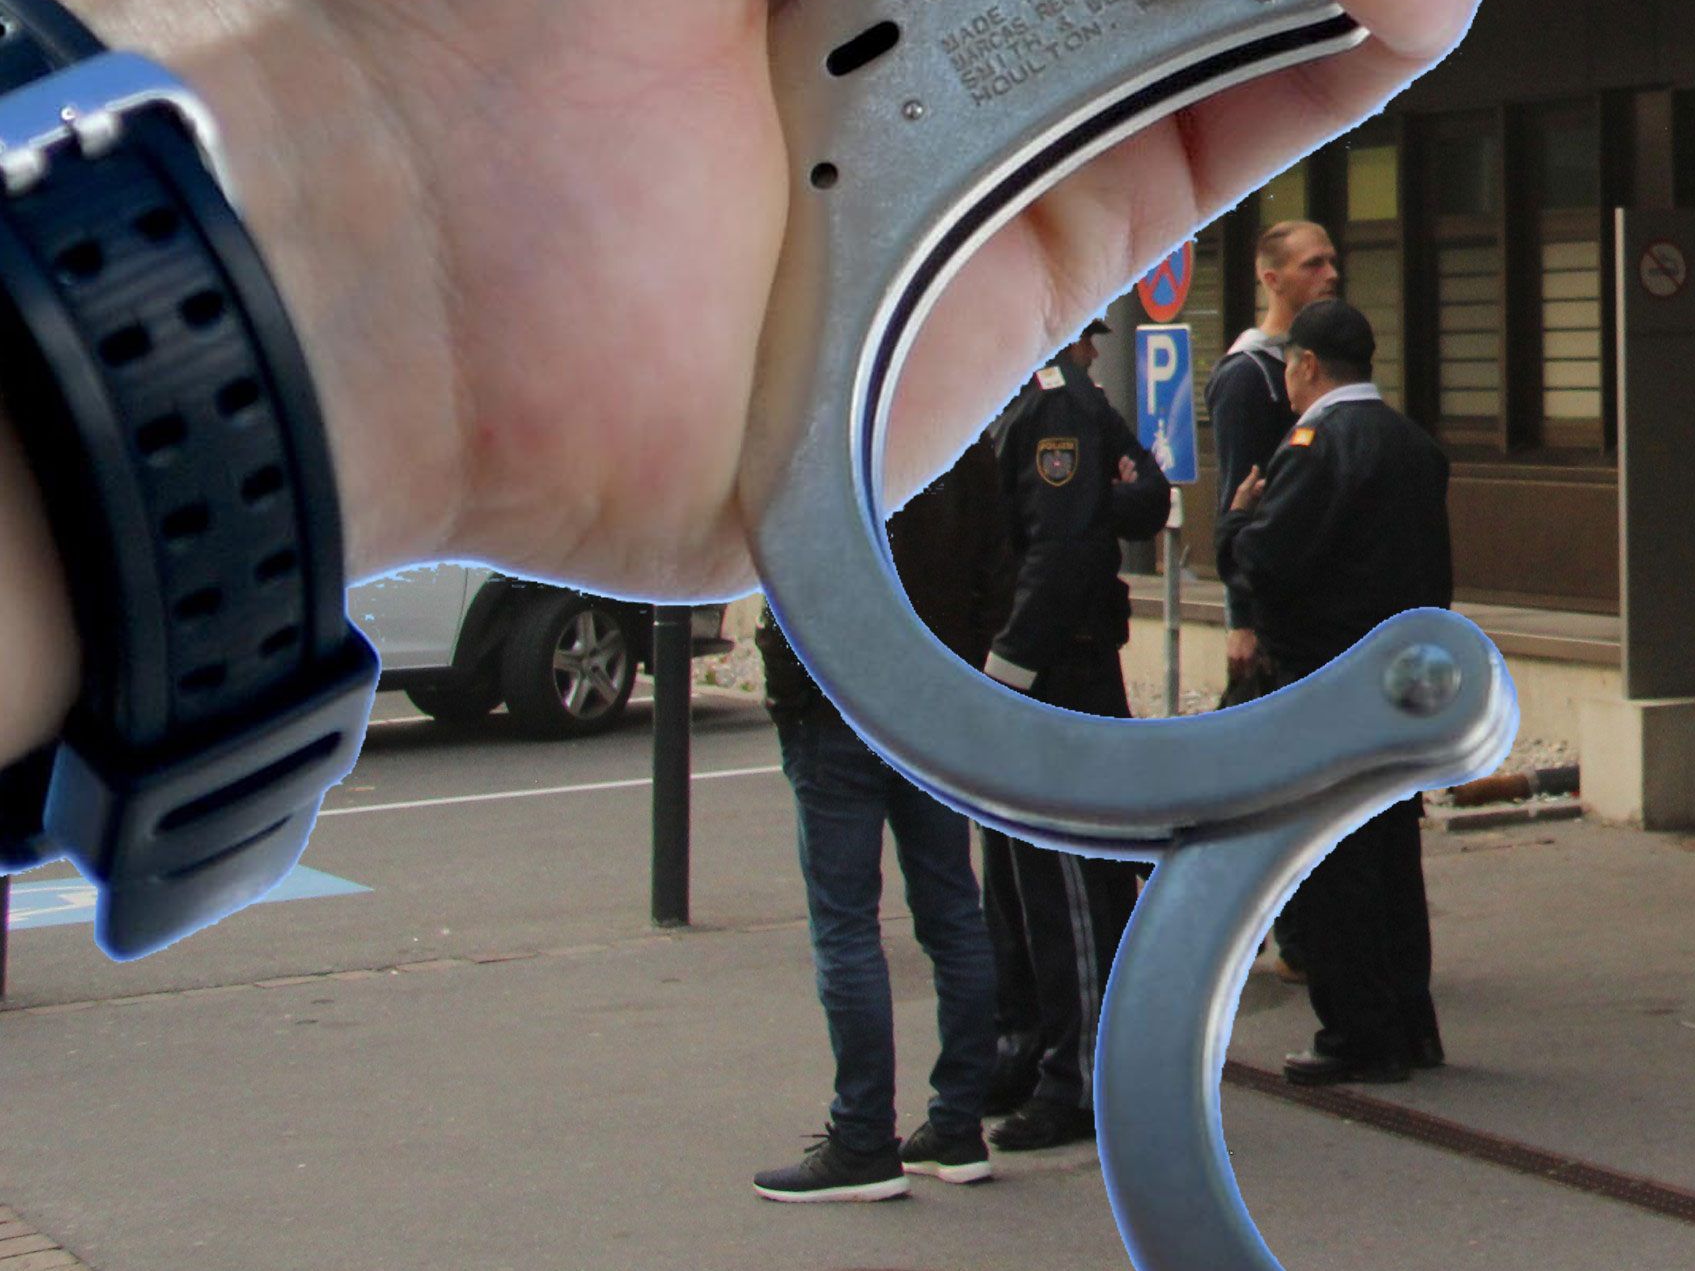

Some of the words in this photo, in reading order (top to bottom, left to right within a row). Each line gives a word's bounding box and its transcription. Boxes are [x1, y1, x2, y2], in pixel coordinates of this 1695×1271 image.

[940, 6, 1006, 54] MADE
[960, 33, 1042, 91] SMITH
[1147, 334, 1177, 416] P
